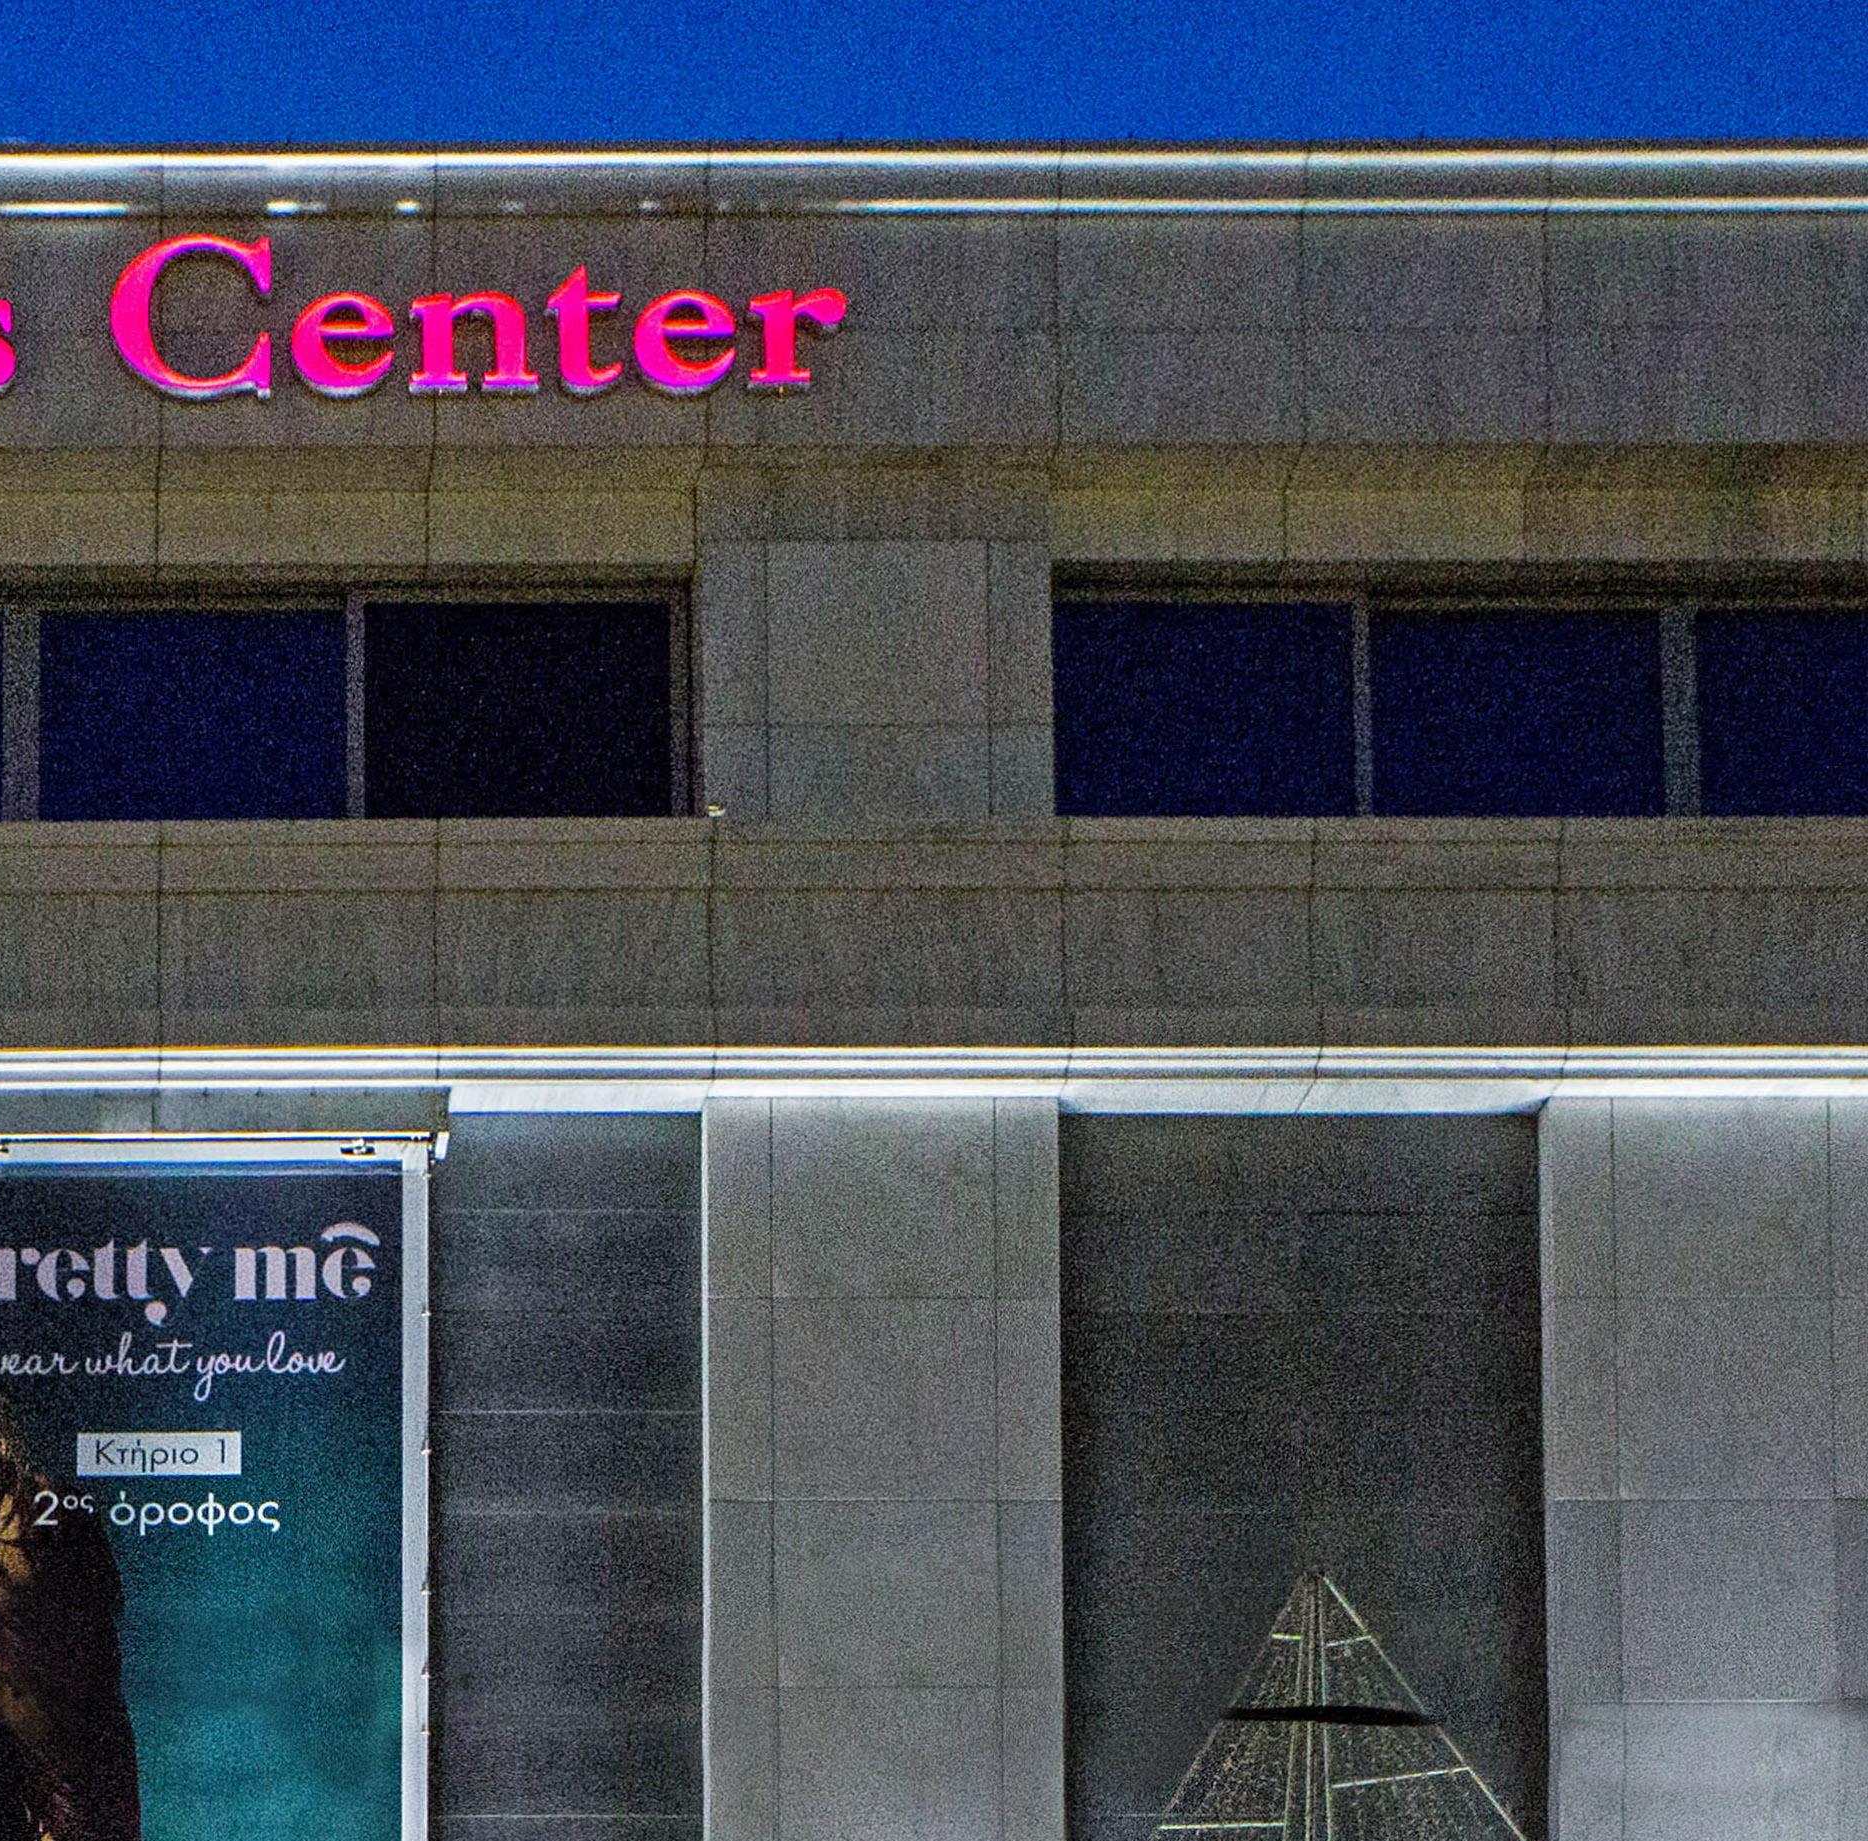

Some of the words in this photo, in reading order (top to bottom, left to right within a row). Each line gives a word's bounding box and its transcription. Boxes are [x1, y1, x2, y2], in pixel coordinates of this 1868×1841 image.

[112, 234, 849, 402] Center
[86, 1332, 192, 1376] what
[195, 1351, 265, 1402] you
[264, 1330, 347, 1374] love
[94, 1438, 200, 1473] Κτήριο
[216, 1438, 229, 1464] 1
[109, 1491, 281, 1536] όροφος
